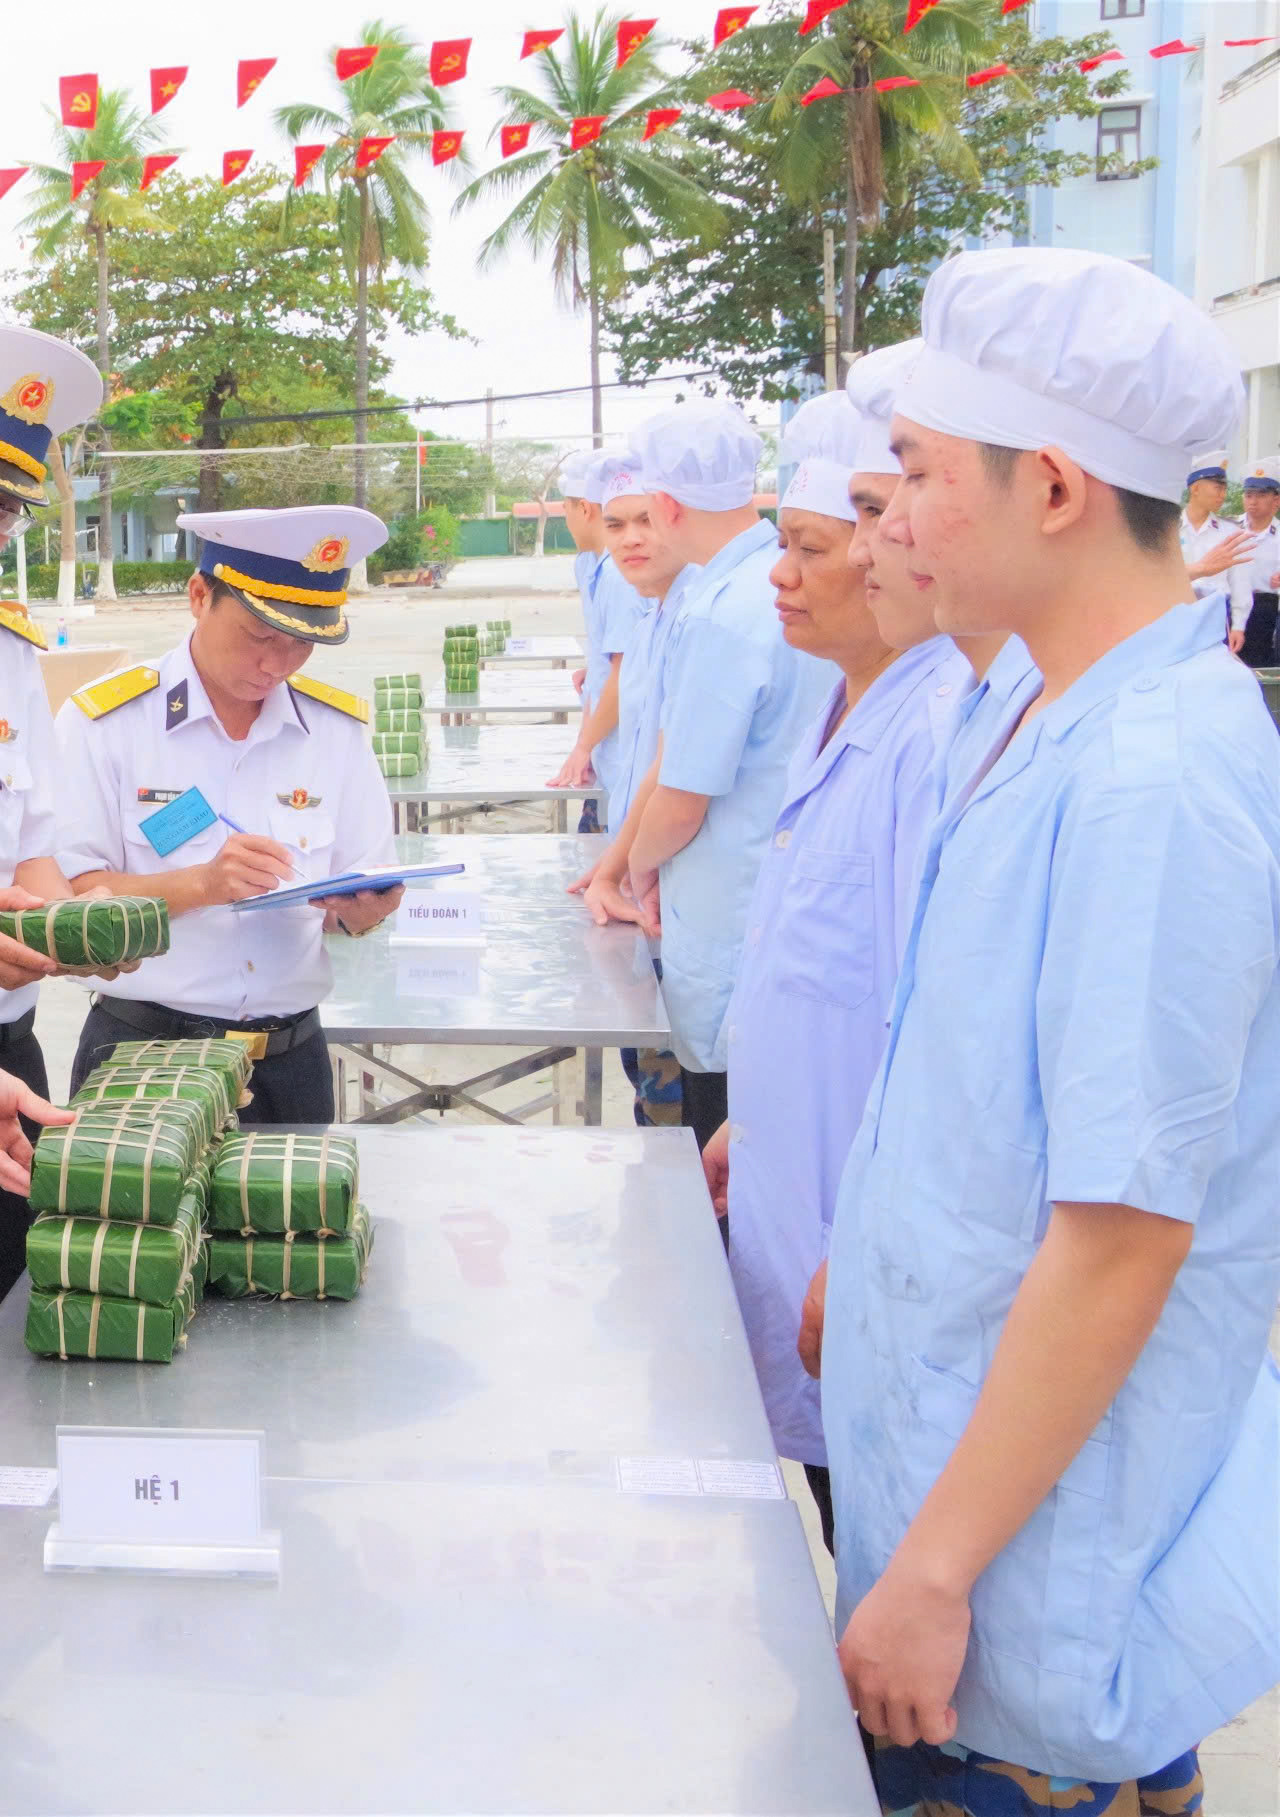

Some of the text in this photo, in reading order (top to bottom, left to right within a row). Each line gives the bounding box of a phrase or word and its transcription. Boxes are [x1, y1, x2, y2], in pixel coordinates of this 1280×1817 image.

[408, 904, 429, 919] TIỂU
[432, 905, 459, 919] ĐOÀN
[134, 1474, 181, 1506] HỆ 1
